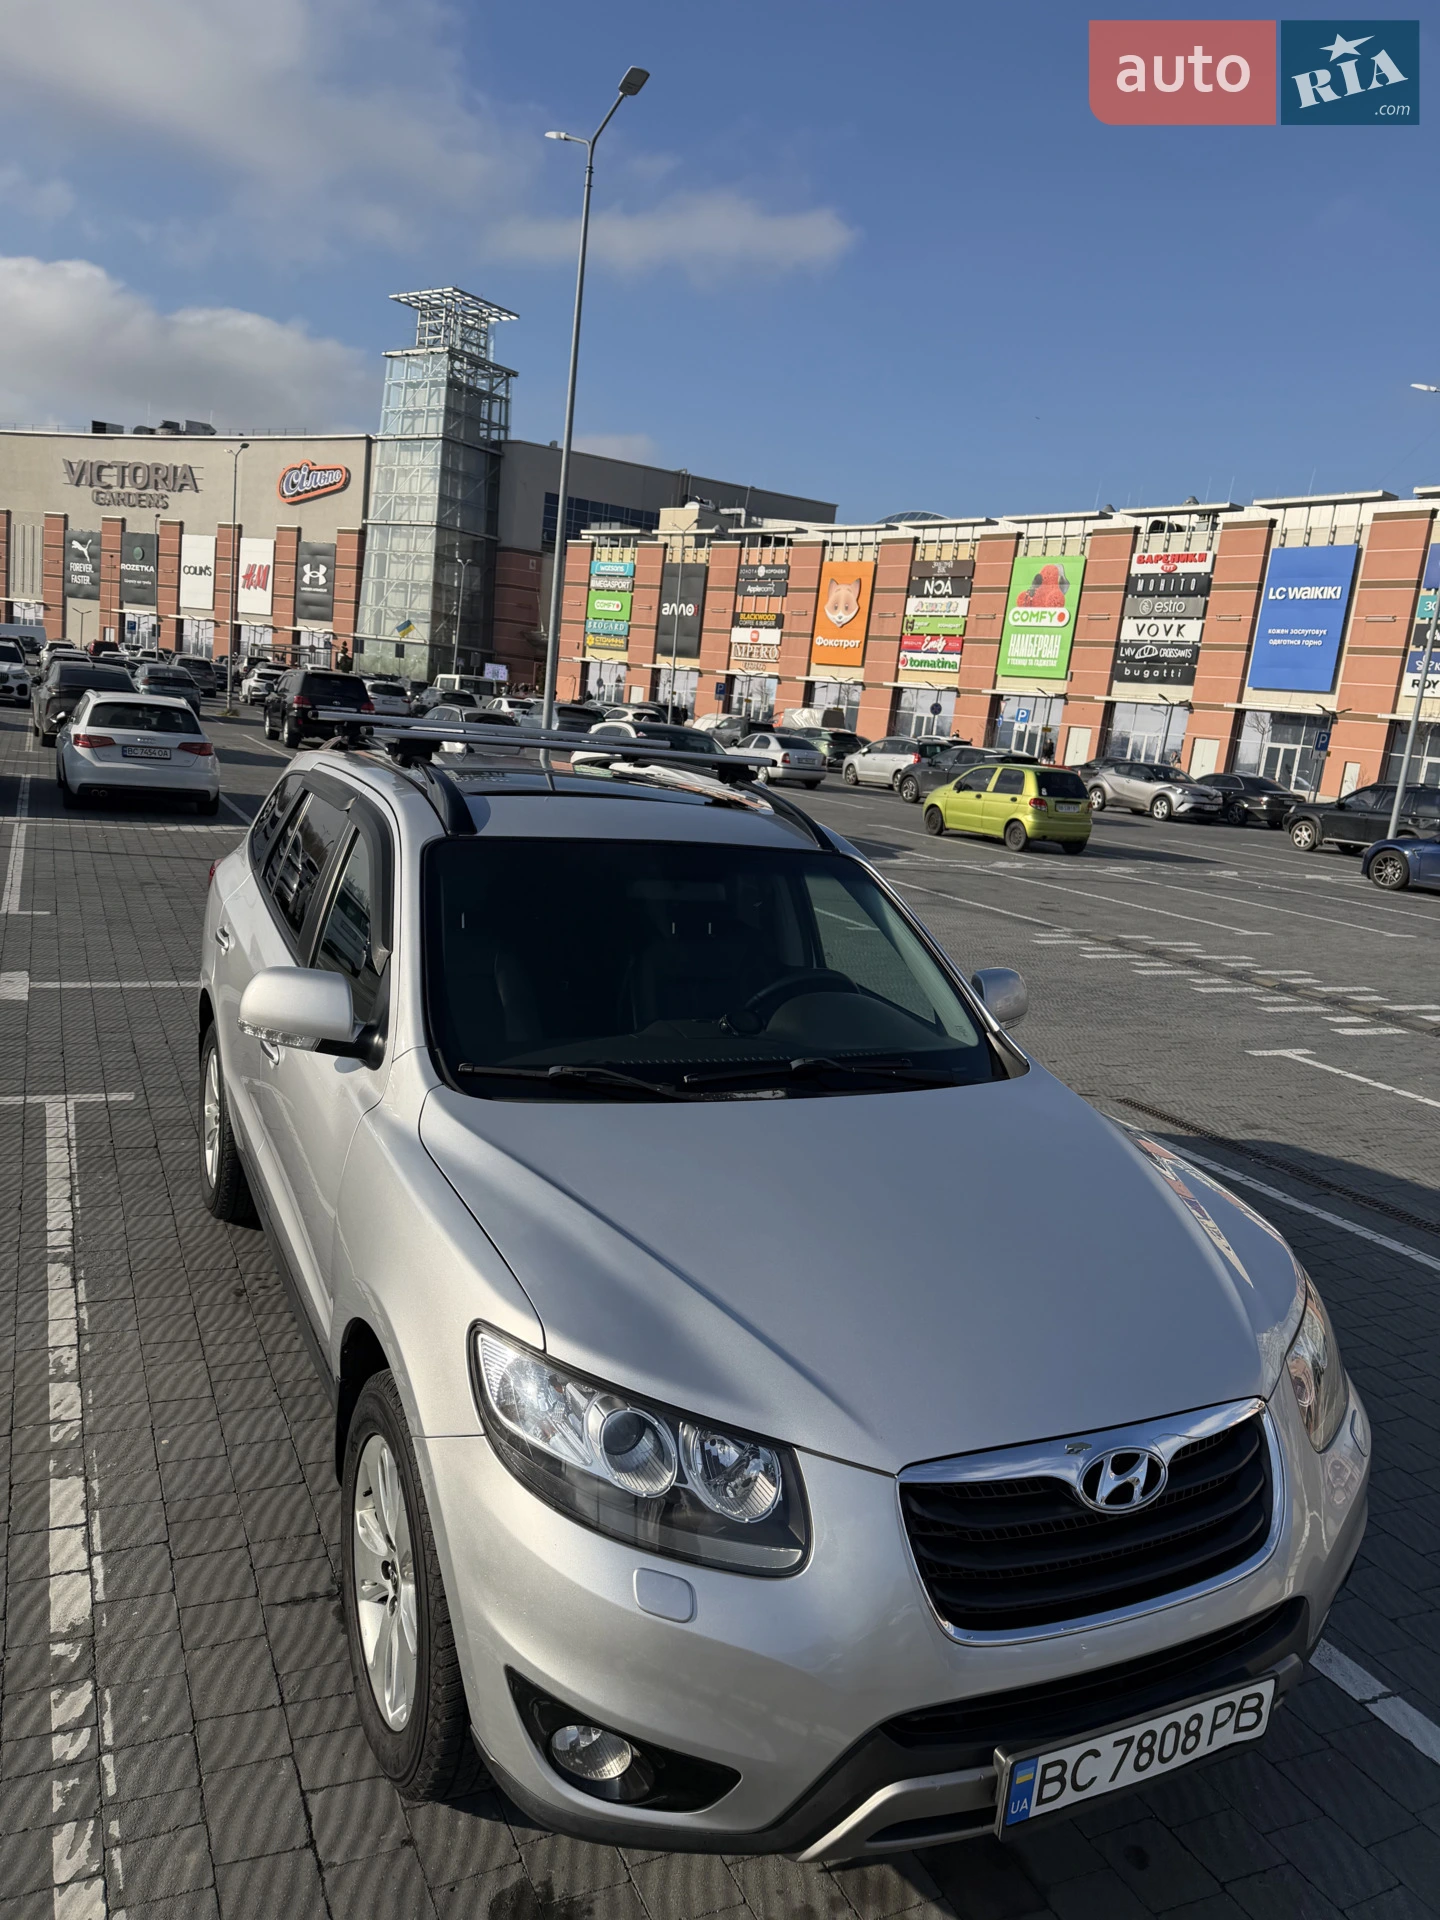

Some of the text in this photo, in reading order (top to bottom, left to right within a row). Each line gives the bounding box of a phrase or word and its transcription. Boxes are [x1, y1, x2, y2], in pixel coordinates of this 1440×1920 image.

[63, 458, 200, 493] VICTORIA
[284, 465, 343, 495] Сільпо
[92, 489, 169, 509] GARDENS
[1136, 552, 1207, 564] ВАРЕНИКИ
[69, 562, 94, 573] FOREVER.
[121, 563, 155, 573] ROZETKA
[183, 565, 212, 577] COLIN'S
[70, 574, 92, 585] FASTER.
[242, 564, 270, 591] H&M
[594, 580, 630, 589] MEGASPORT
[924, 580, 952, 595] NOA
[1137, 578, 1196, 591] MOHITO
[1268, 586, 1286, 600] LC
[596, 601, 615, 609] COMFY
[1154, 600, 1185, 613] estro
[740, 613, 776, 621] BLACKWOOD
[1012, 610, 1057, 623] COMFY
[588, 622, 625, 631] BROCARD
[1136, 623, 1186, 638] VOVK
[815, 636, 861, 648] Фокстрот
[1008, 633, 1062, 658] НАМБЕРВАН
[1269, 639, 1322, 648] одягатися гарно
[1159, 648, 1193, 659] CROISSANTS
[909, 657, 958, 669] tomatina
[1124, 667, 1182, 678] bugatti
[127, 747, 138, 755] BC
[1035, 1691, 1265, 1807] BC 7808 PB
[1010, 1800, 1028, 1815] UA
